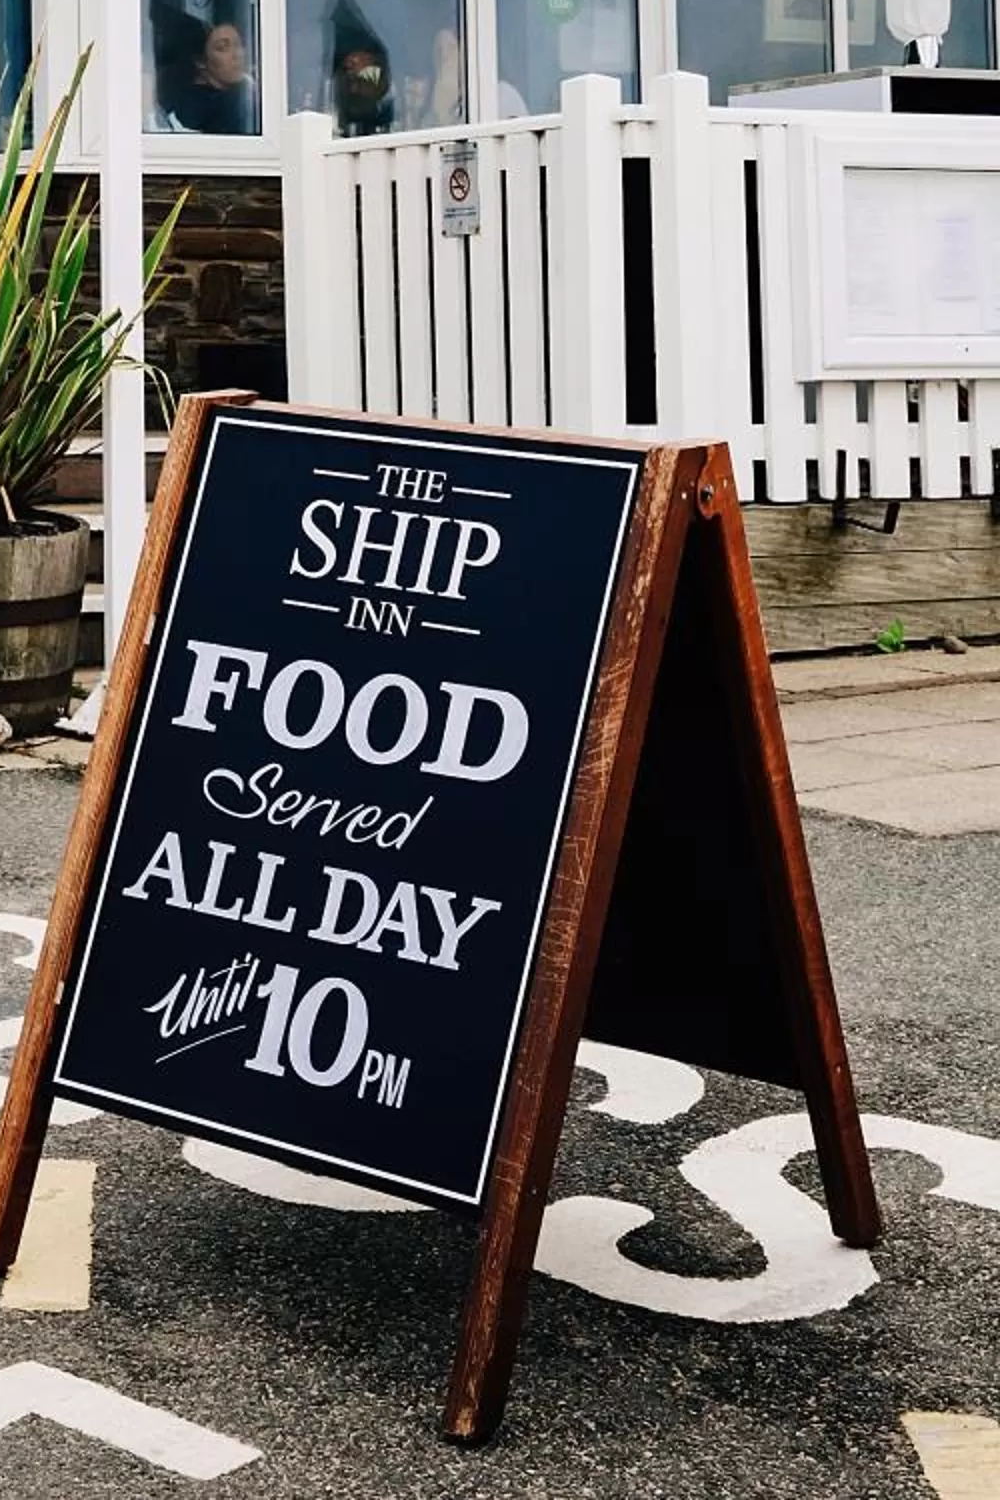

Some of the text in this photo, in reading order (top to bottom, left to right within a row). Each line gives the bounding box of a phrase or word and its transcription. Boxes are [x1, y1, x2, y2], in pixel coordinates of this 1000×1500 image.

[378, 465, 446, 502] THE
[290, 500, 501, 599] SHIP
[345, 596, 415, 637] INN
[172, 640, 529, 782] FOOD
[204, 763, 434, 850] Served
[123, 832, 502, 971] ALL DAY
[144, 953, 260, 1038] Until
